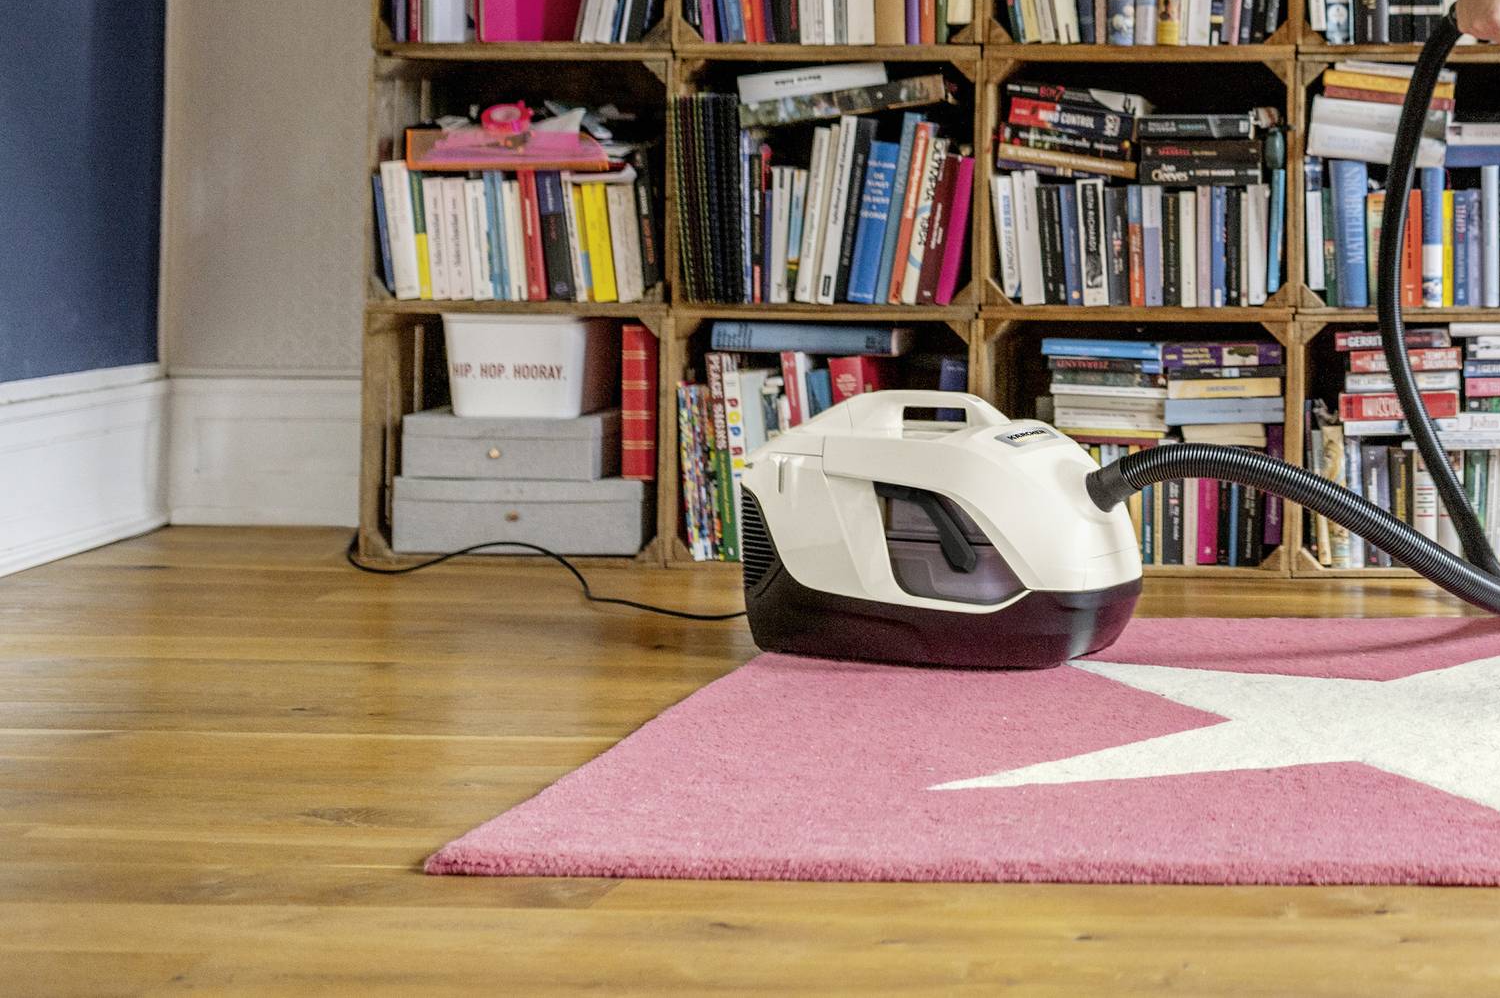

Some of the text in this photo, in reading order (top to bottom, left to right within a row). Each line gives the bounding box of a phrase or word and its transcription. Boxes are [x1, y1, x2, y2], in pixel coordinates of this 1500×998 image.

[1060, 112, 1095, 129] CONTROL
[1086, 210, 1096, 251] RICHARDS
[1344, 167, 1364, 265] MATTERHORN
[453, 363, 567, 381] HIP. HOP. HOORAY.
[711, 353, 727, 451] PEACE SIGNS
[728, 398, 742, 436] POP
